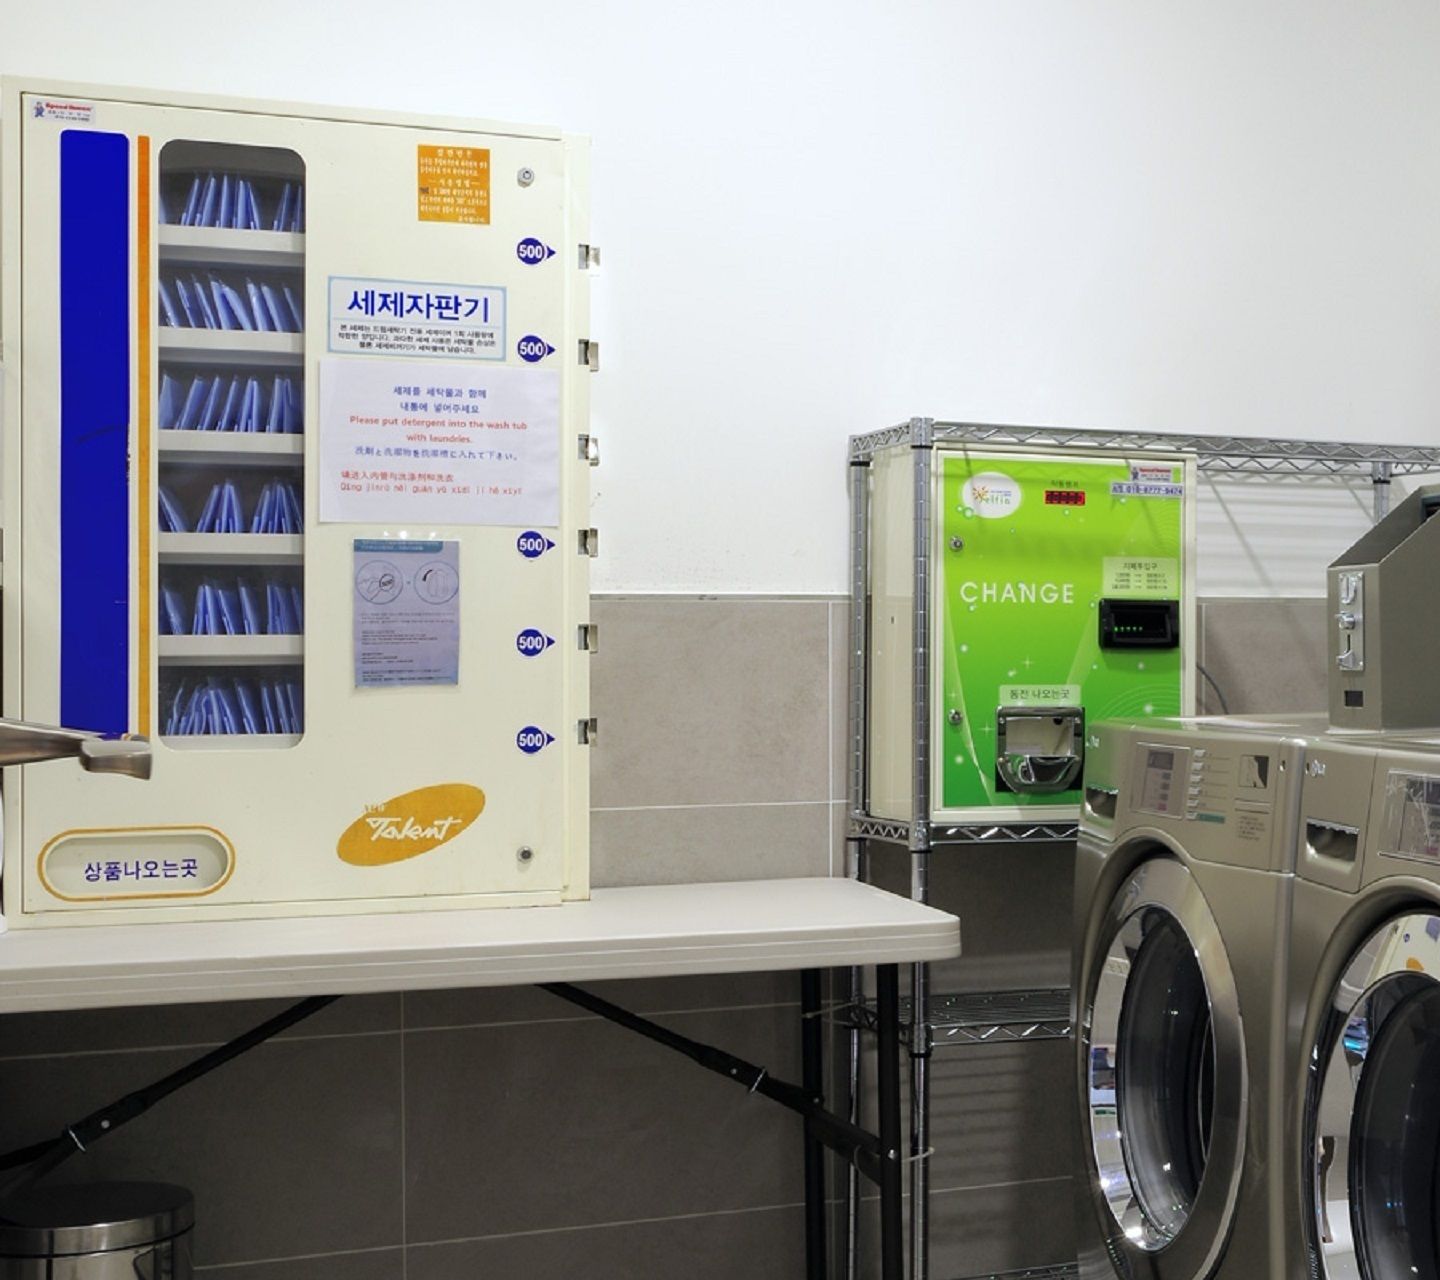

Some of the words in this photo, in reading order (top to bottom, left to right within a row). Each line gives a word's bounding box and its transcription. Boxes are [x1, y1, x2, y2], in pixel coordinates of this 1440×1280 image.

[519, 244, 543, 259] 500
[348, 290, 488, 323] 세제자판기
[520, 341, 544, 356] 500
[350, 416, 379, 425] Please
[382, 418, 398, 426] put
[402, 418, 445, 428] detergent
[449, 420, 466, 428] into
[469, 421, 484, 429] the
[487, 421, 509, 429] wash
[512, 422, 527, 430] tub
[407, 434, 427, 442] with
[519, 538, 543, 552] 500
[959, 581, 1074, 605] CHANGE
[519, 635, 543, 649] 500
[519, 733, 543, 747] 500
[365, 816, 462, 841] Talent
[85, 858, 198, 882] 상품나오는곳
